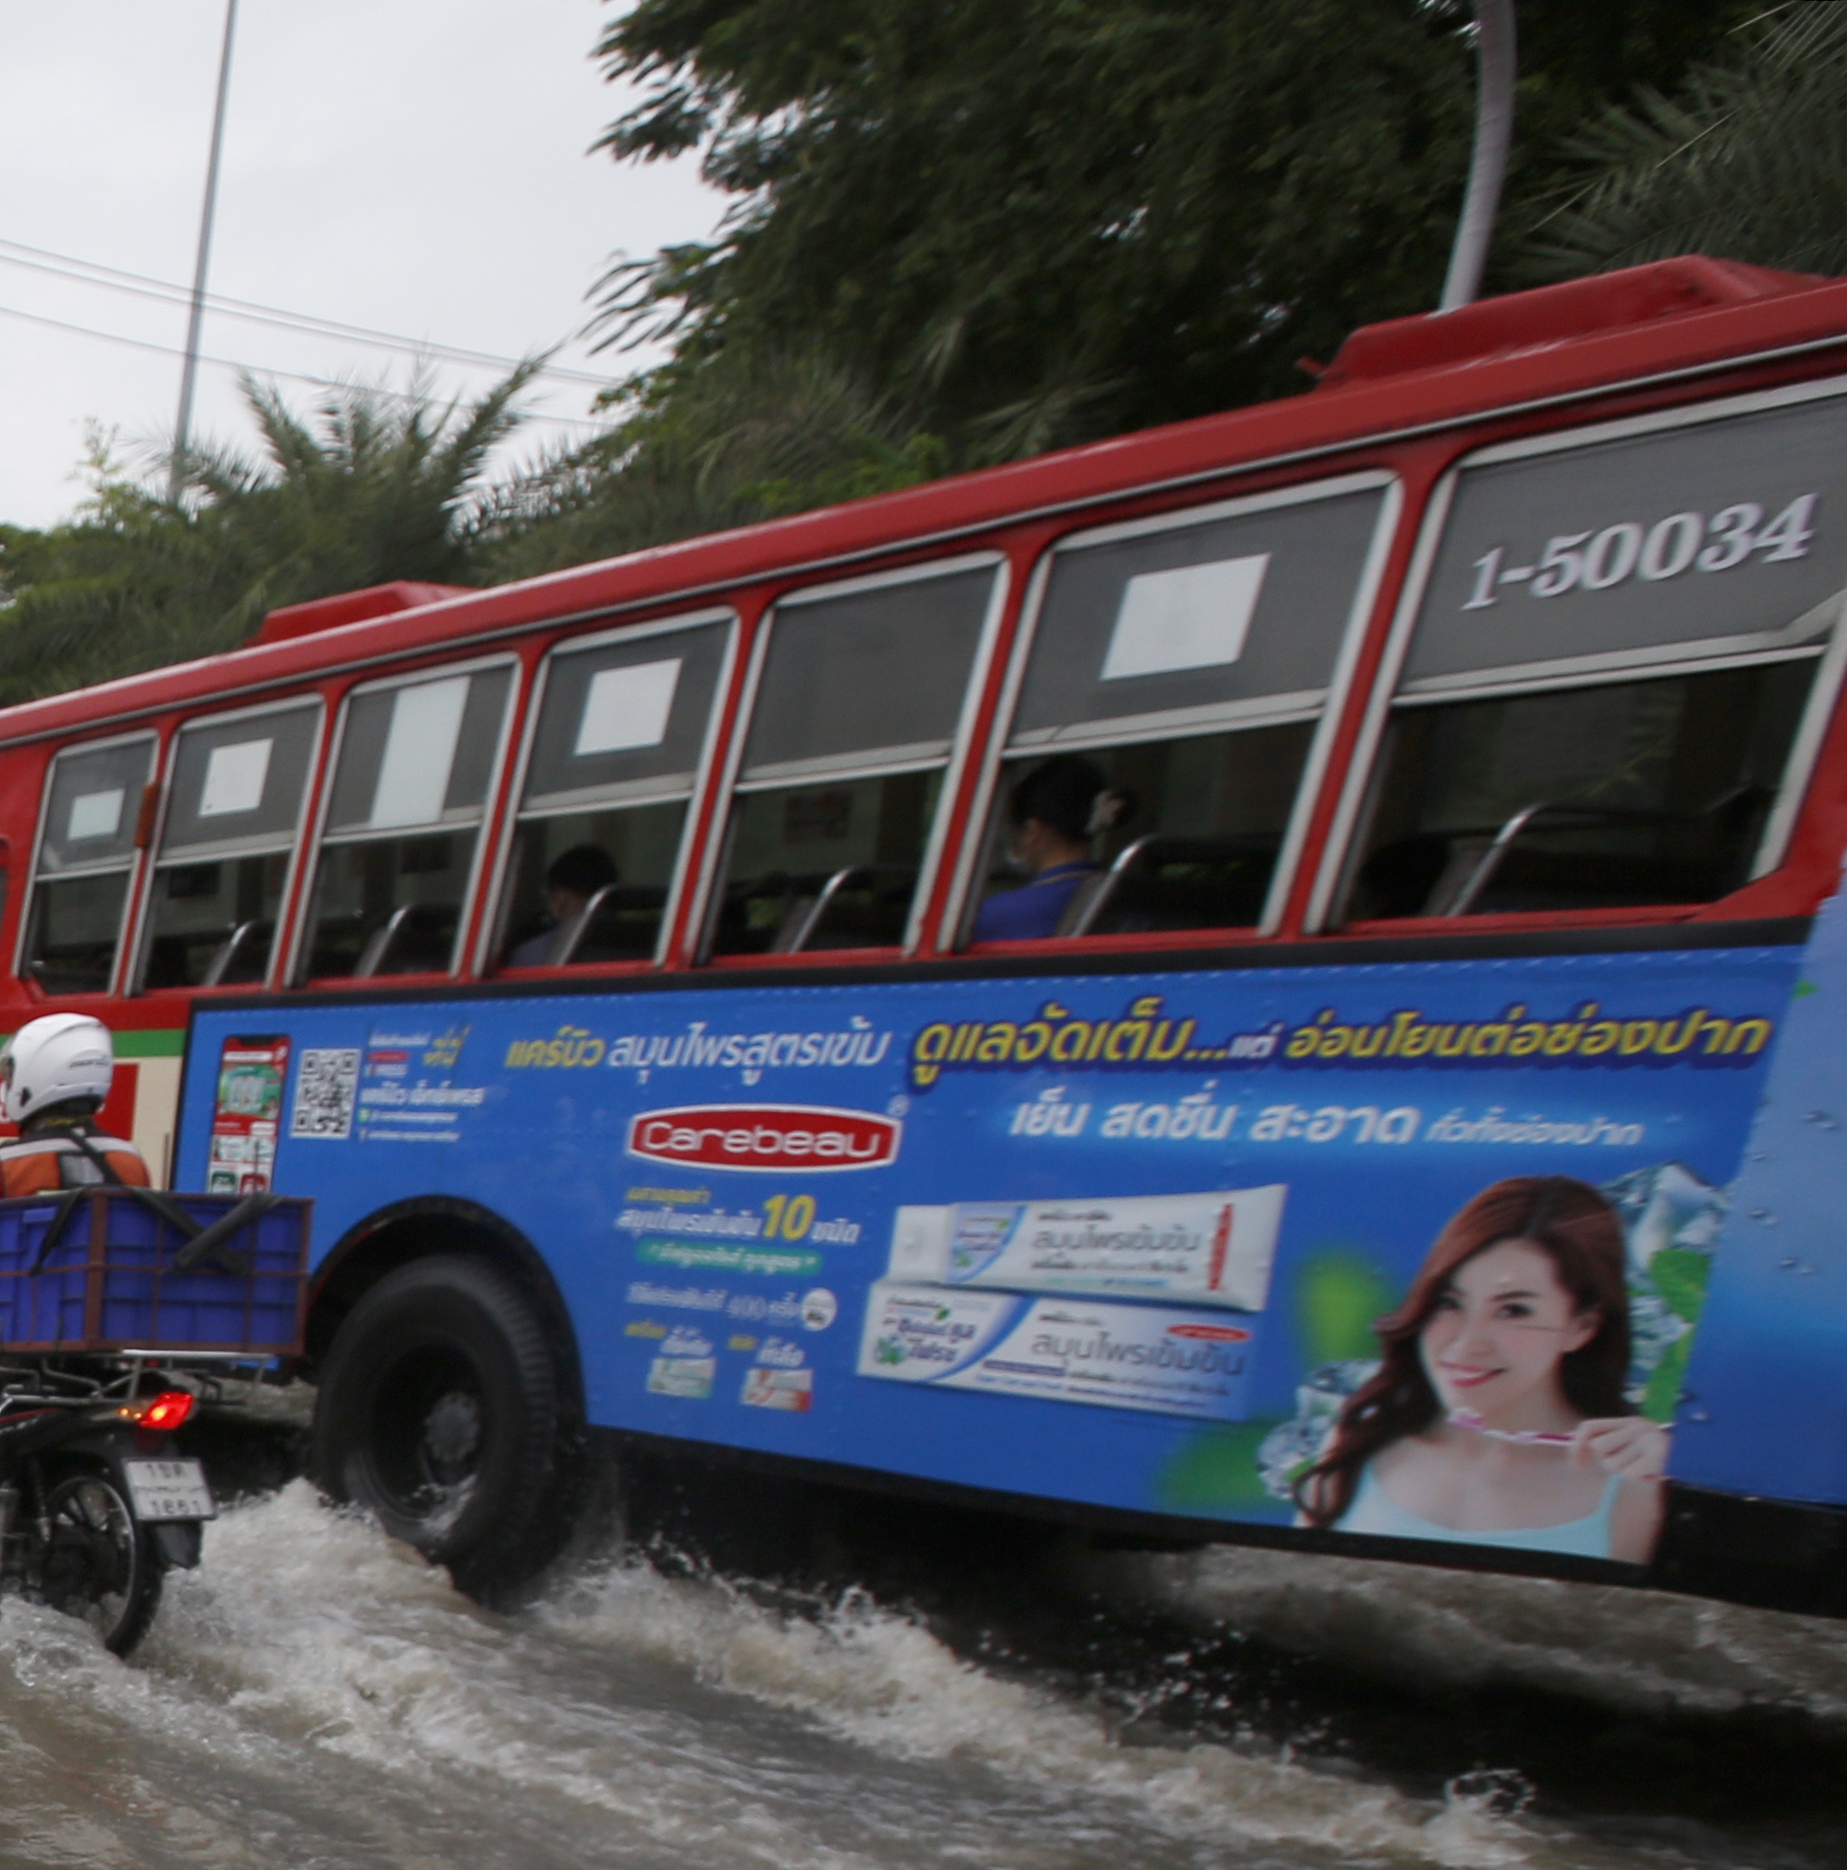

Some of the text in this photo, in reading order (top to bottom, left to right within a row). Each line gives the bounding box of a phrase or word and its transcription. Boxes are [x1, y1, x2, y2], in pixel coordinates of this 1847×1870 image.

[1460, 492, 1818, 611] 1-50034
[1285, 1001, 1772, 1058] อ่อนโยนต่อช่องปาก
[1010, 1085, 1090, 1137] เย็น
[1101, 1079, 1238, 1140] สดชื่น
[1249, 1104, 1422, 1143] สะอาด
[644, 1121, 881, 1159] Carebeau
[762, 1194, 817, 1241] 10
